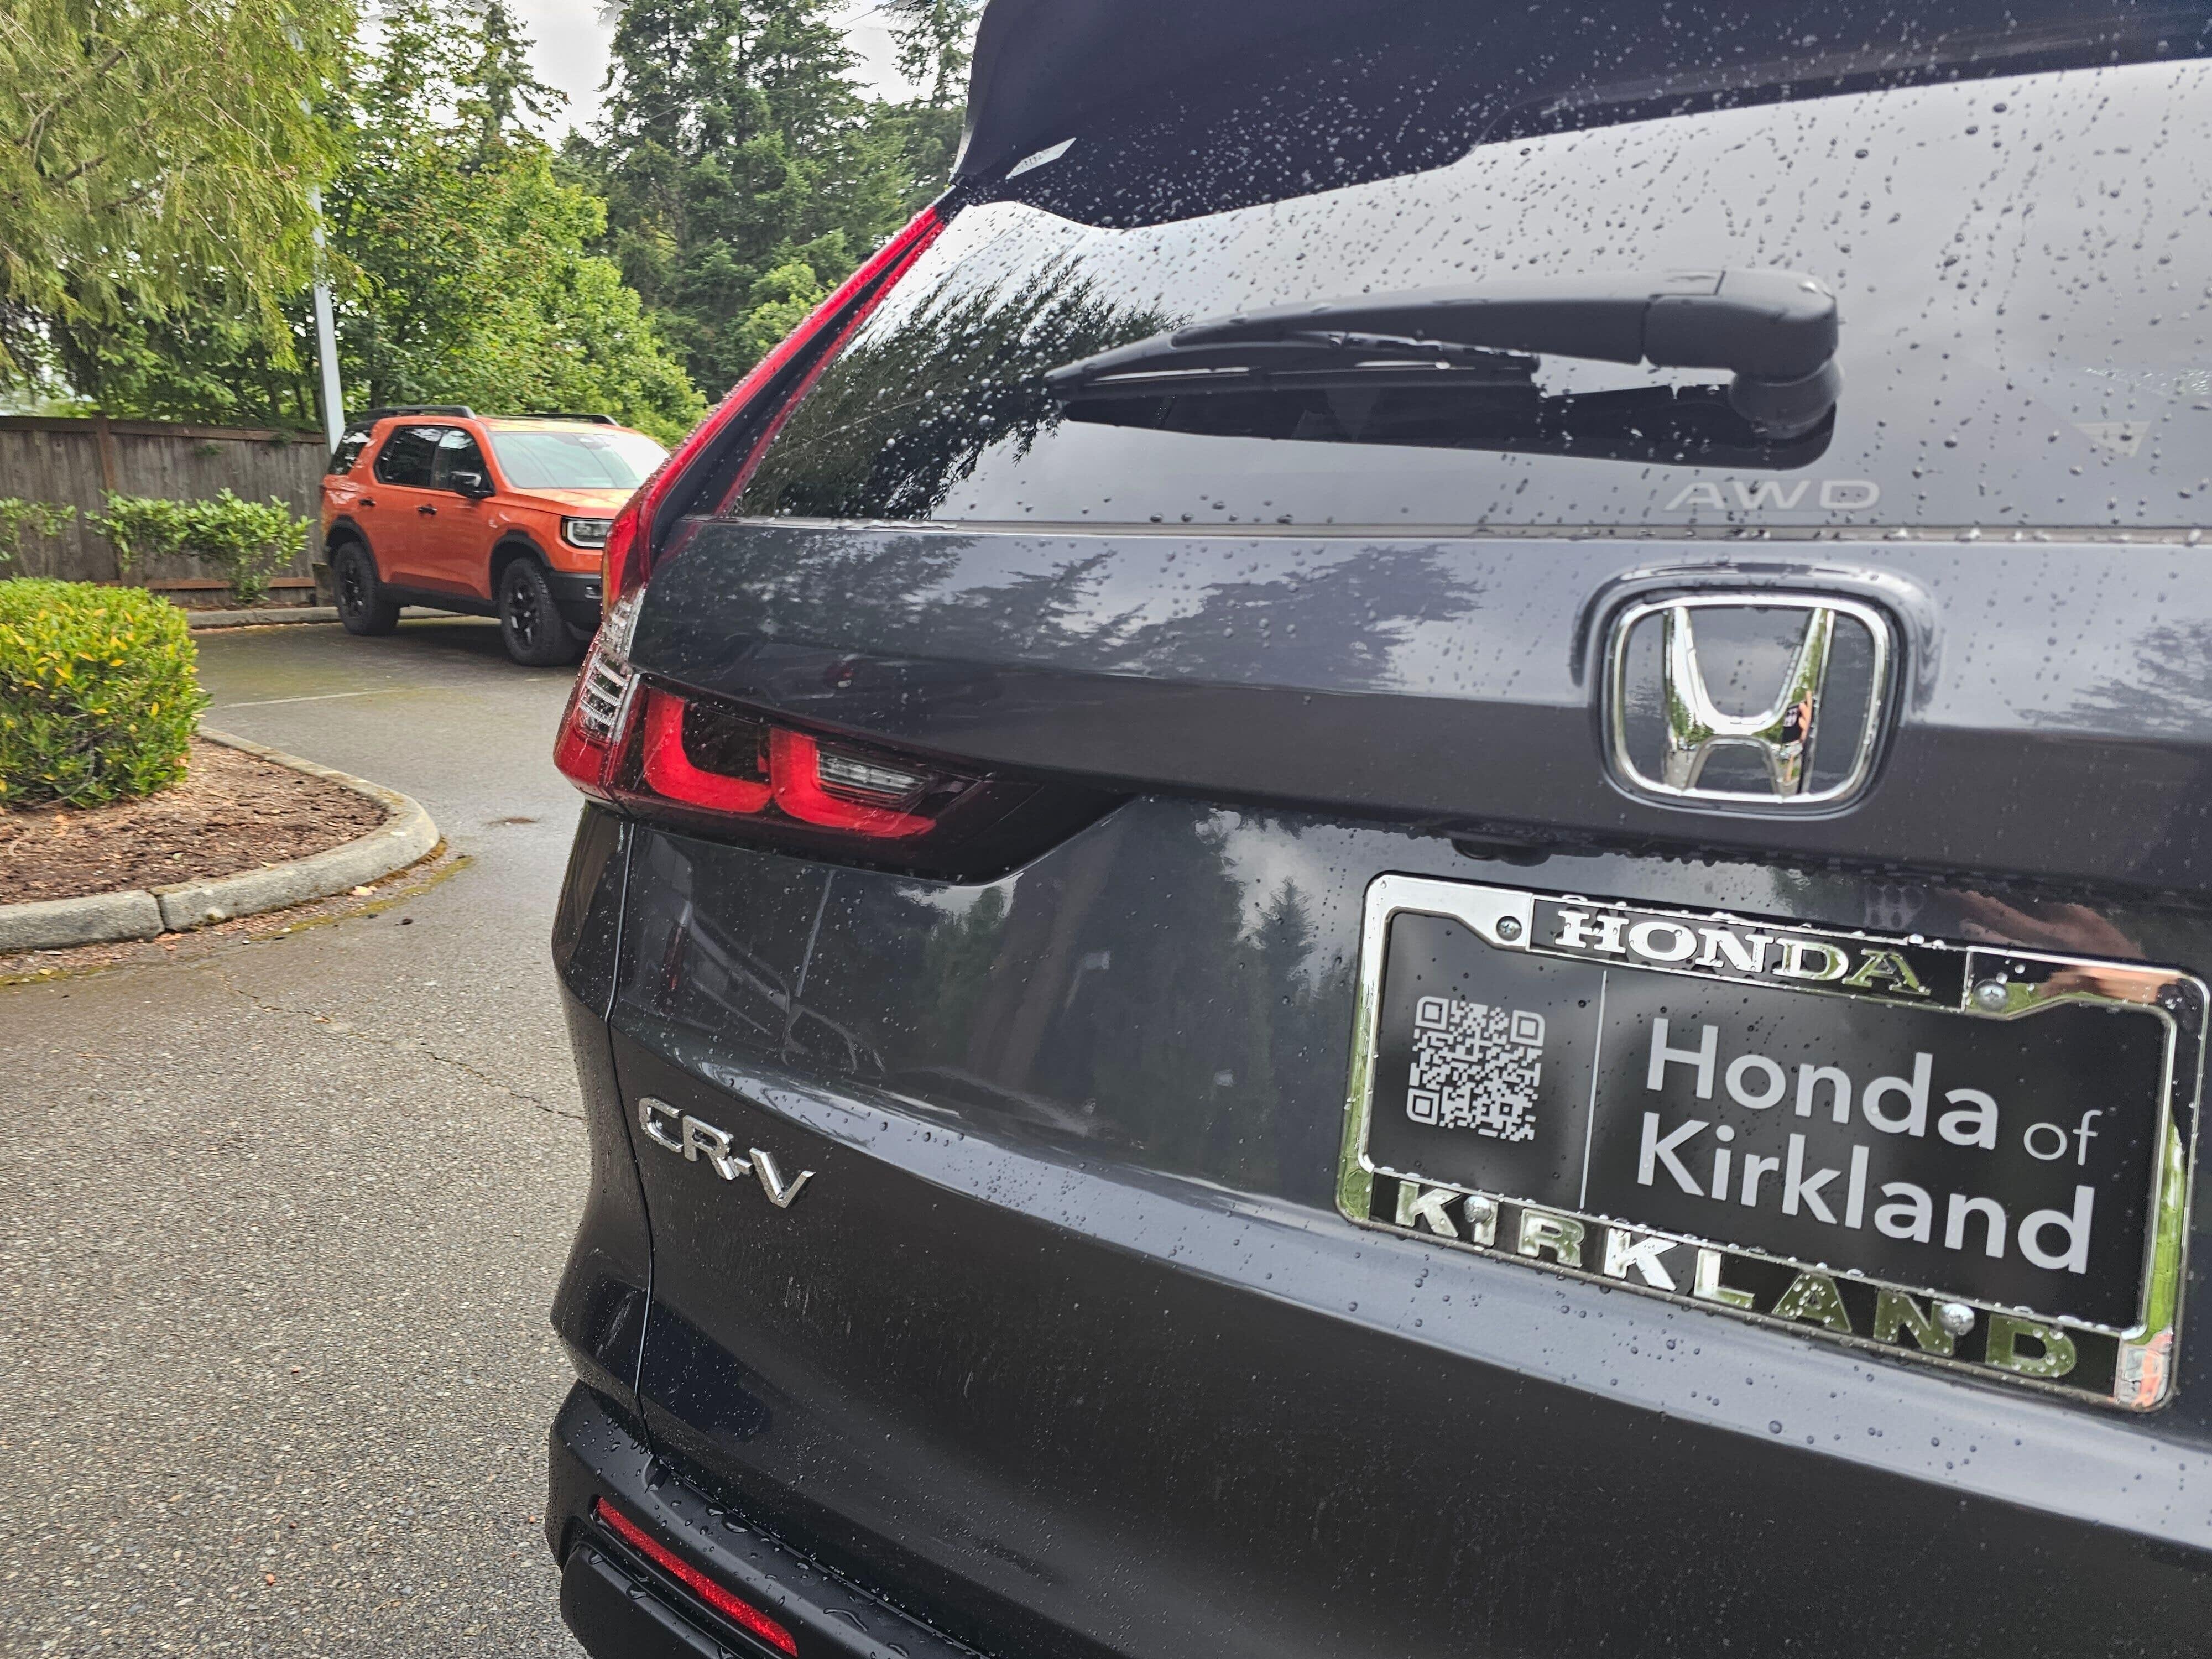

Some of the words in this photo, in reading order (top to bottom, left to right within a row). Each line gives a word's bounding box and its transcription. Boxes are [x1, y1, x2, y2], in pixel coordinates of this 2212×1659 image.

[1665, 479, 1880, 510] AWD
[1554, 909, 1932, 994] HONDA
[639, 1097, 816, 1208] CR-V
[1647, 1018, 1999, 1150] Honda
[2023, 1110, 2101, 1166] of
[1637, 1112, 2094, 1274] Kirkland
[1395, 1181, 2077, 1377] KIRKLAND
